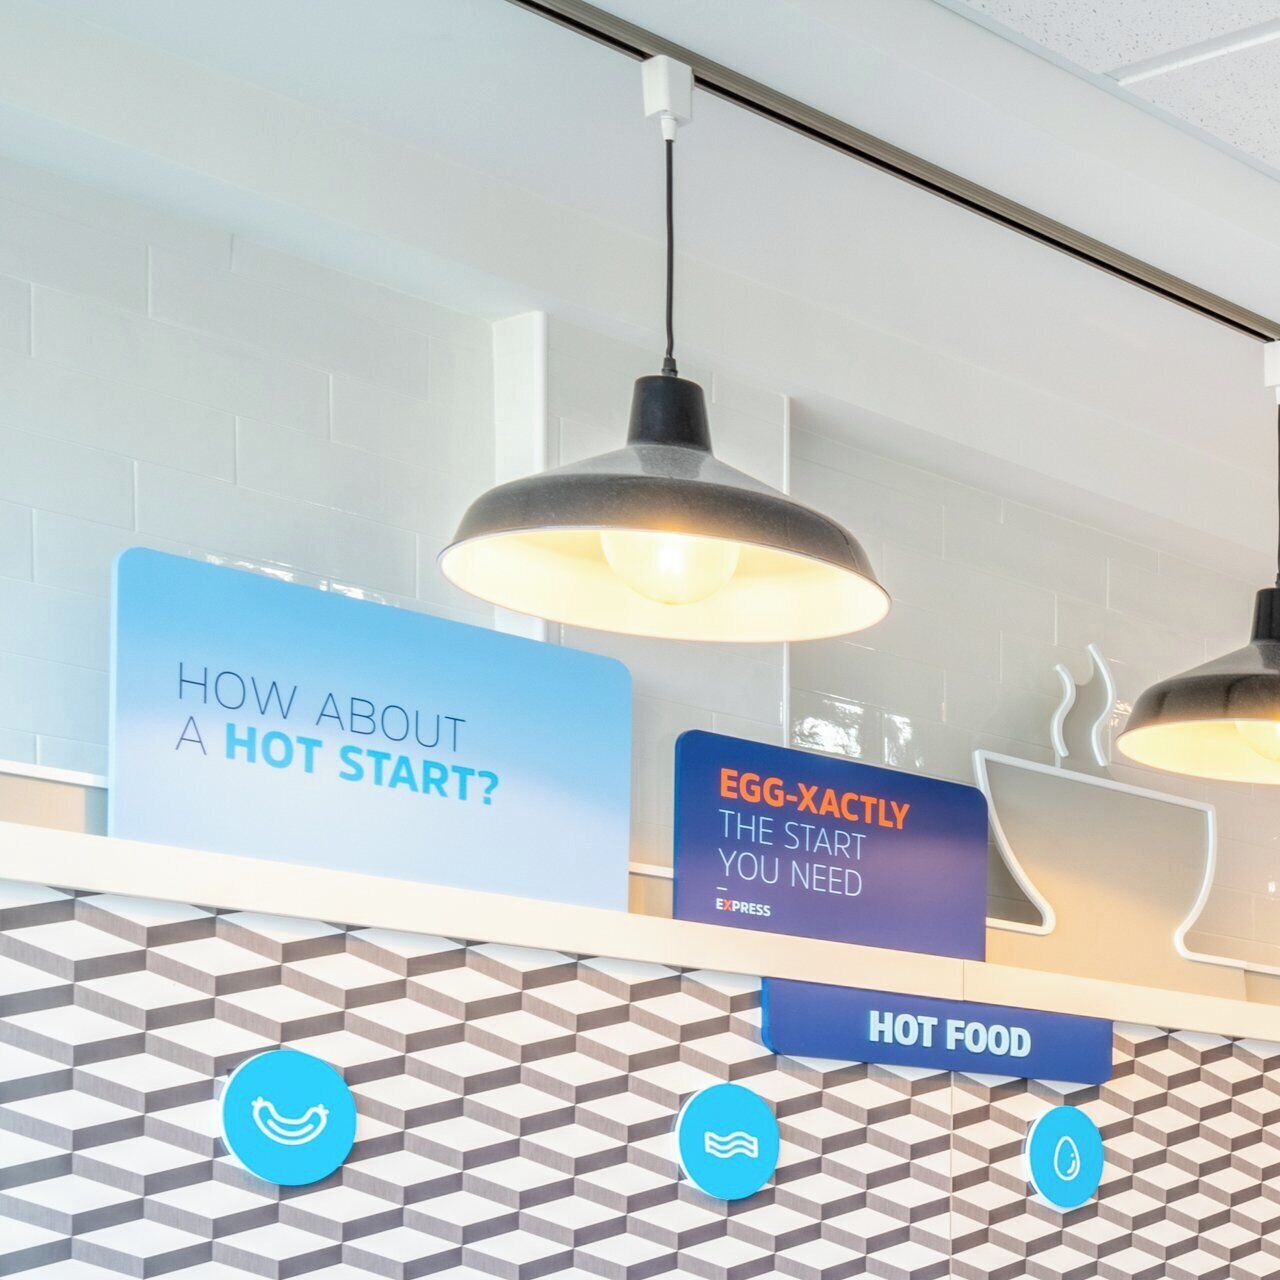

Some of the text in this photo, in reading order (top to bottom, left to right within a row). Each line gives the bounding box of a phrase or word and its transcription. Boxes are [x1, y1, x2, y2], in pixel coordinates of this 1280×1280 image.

[178, 662, 466, 752] HOW ABOUT
[175, 715, 499, 805] A HOT START?
[719, 768, 910, 830] EGG-XACTLY
[718, 808, 866, 860] THE START
[718, 847, 862, 897] YOU NEED
[716, 898, 771, 917] EXPRESS
[869, 1010, 1031, 1057] HOT FOOD
